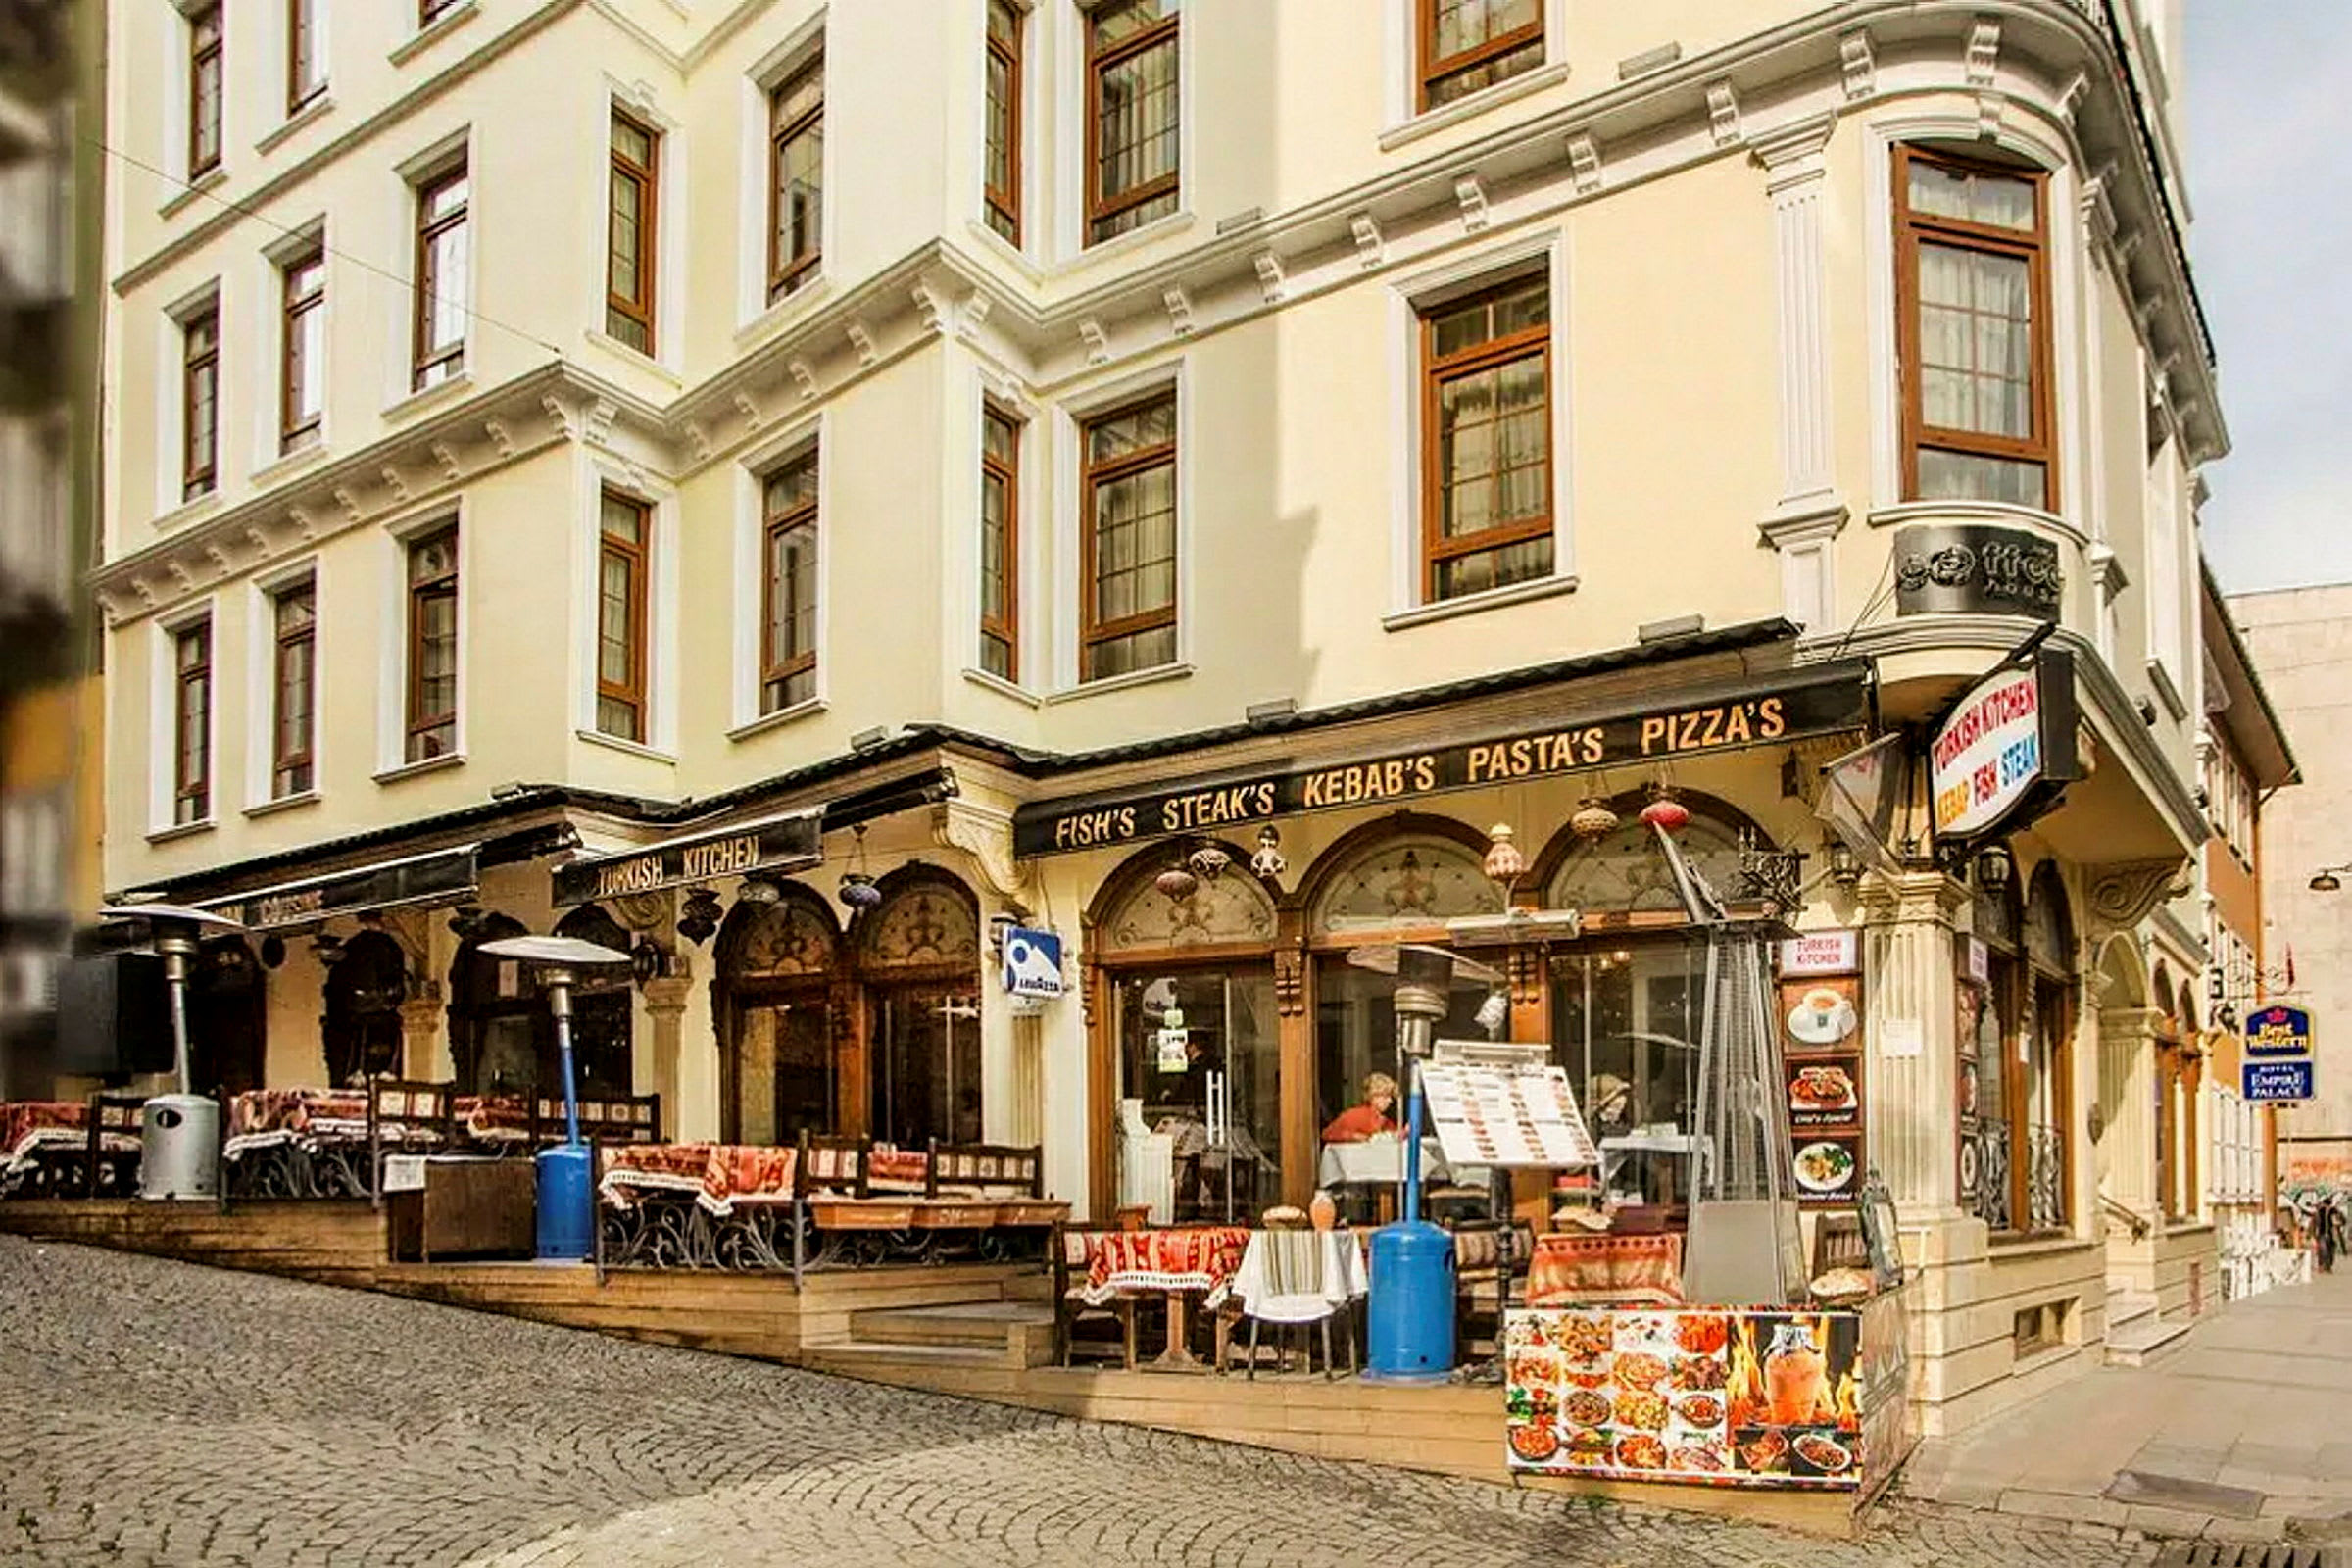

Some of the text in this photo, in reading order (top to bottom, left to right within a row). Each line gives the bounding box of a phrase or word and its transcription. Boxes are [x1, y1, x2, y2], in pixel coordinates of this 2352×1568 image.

[1982, 677, 2036, 733] KITCHEN
[1054, 697, 1786, 849] FISH'S STEAK'S KEBAB'S PASTA'S PIZZA'S
[1974, 758, 1998, 807] FISH
[597, 835, 760, 895] TURKISH KITCHEN
[1796, 938, 1841, 952] TURKISH
